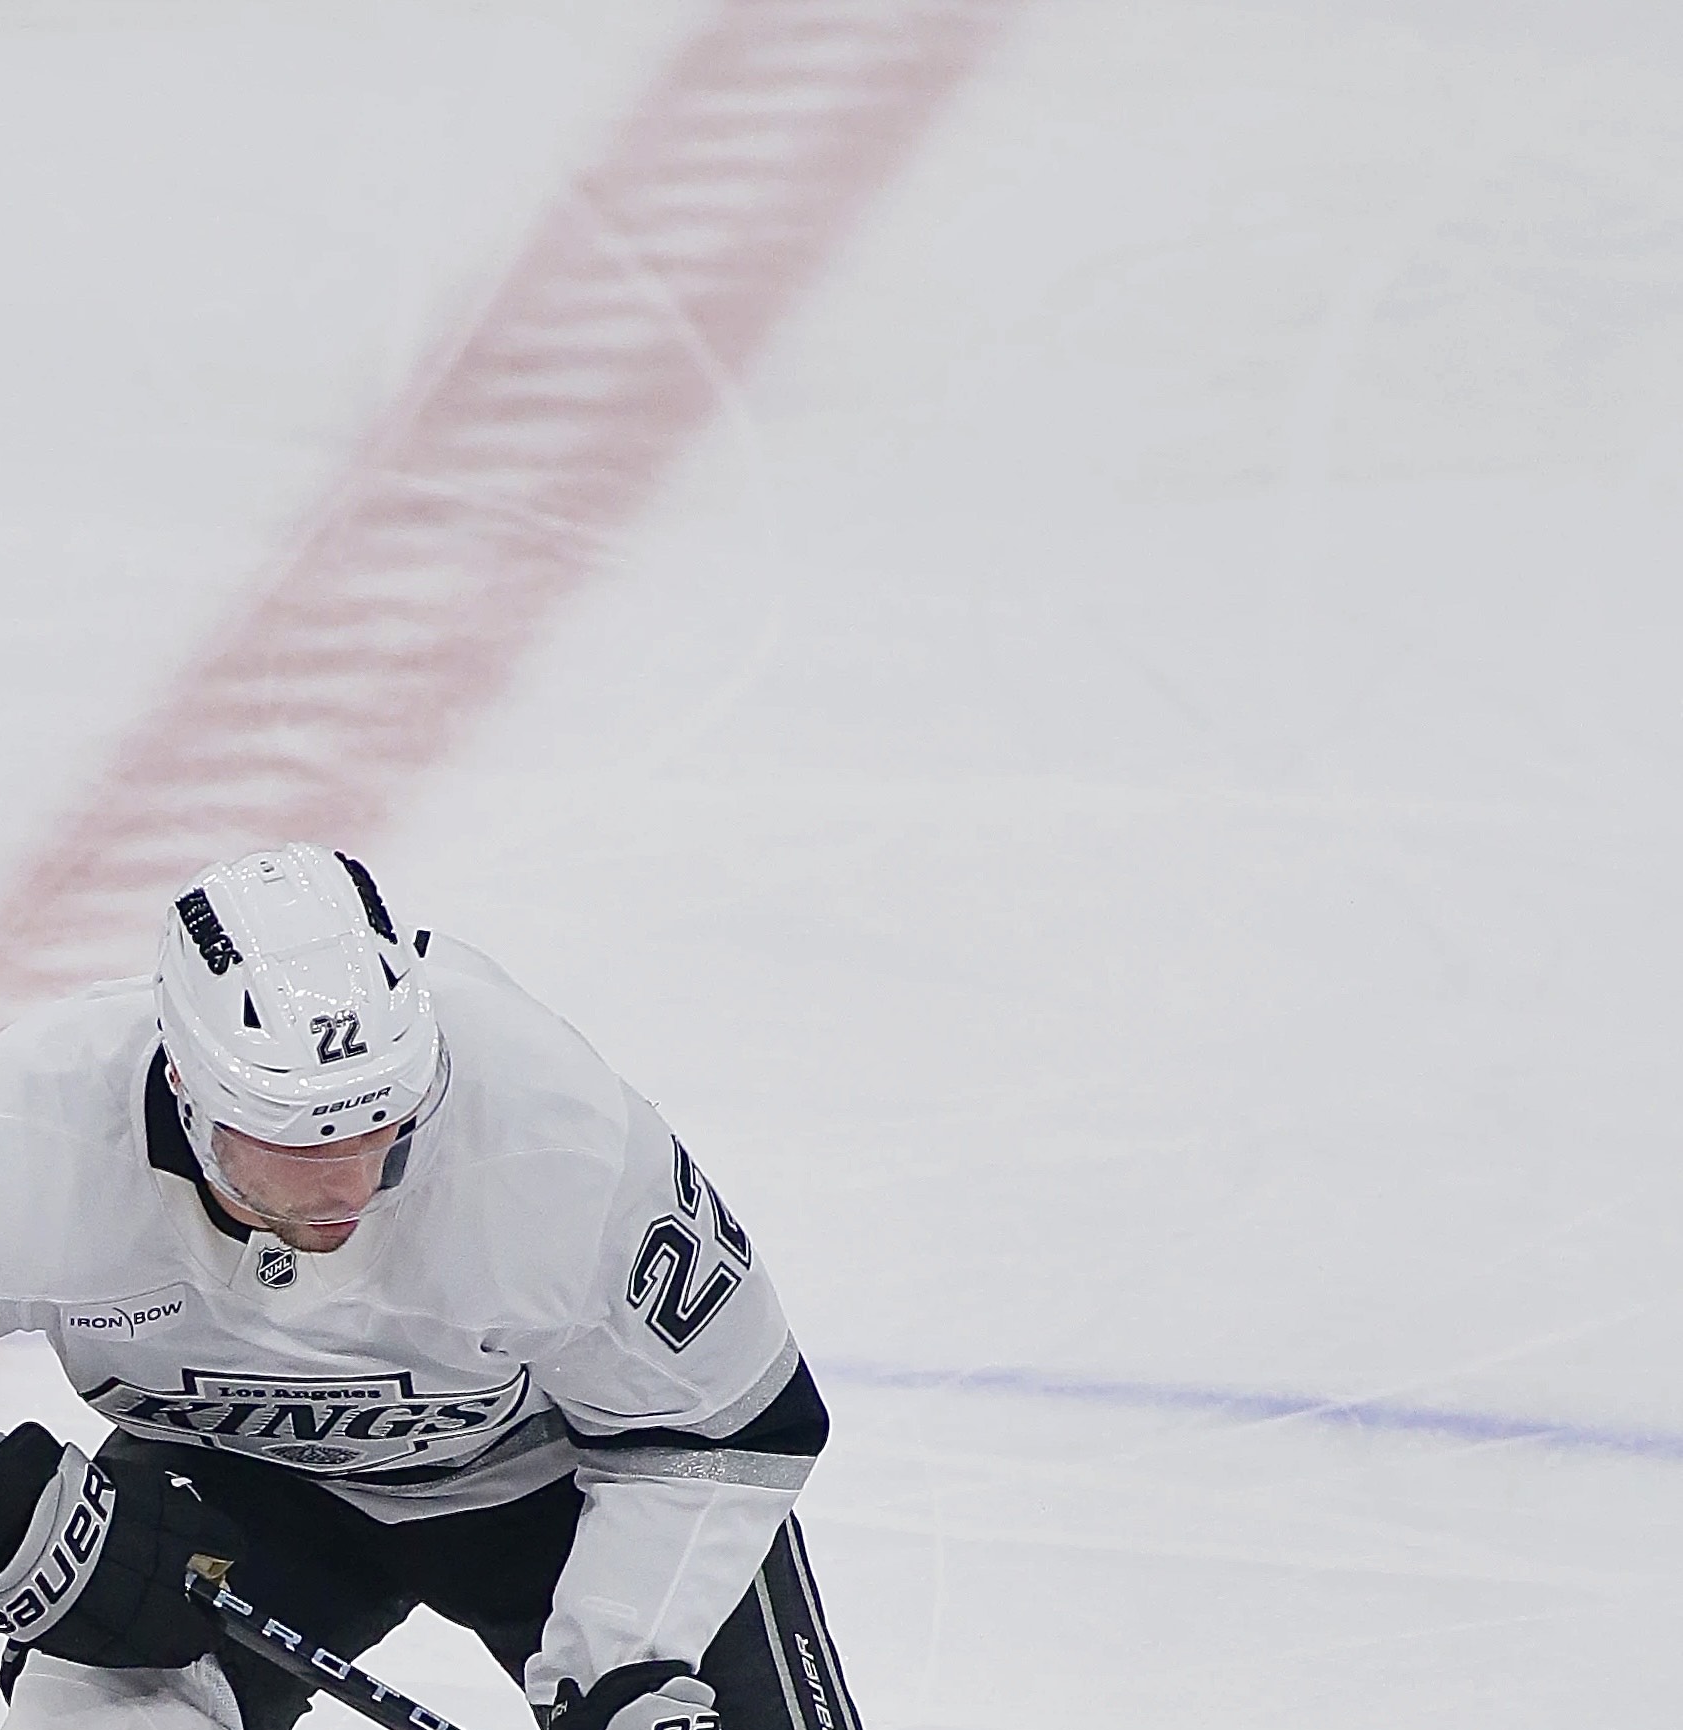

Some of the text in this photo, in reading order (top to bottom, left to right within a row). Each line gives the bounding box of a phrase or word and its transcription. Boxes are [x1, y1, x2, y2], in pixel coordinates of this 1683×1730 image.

[309, 1009, 368, 1065] 22
[311, 1086, 393, 1116] BAUER
[264, 1256, 292, 1281] NHL
[70, 1301, 183, 1329] IRON BOW
[218, 1387, 381, 1401] Los Angeles
[126, 1397, 501, 1440] KINGS
